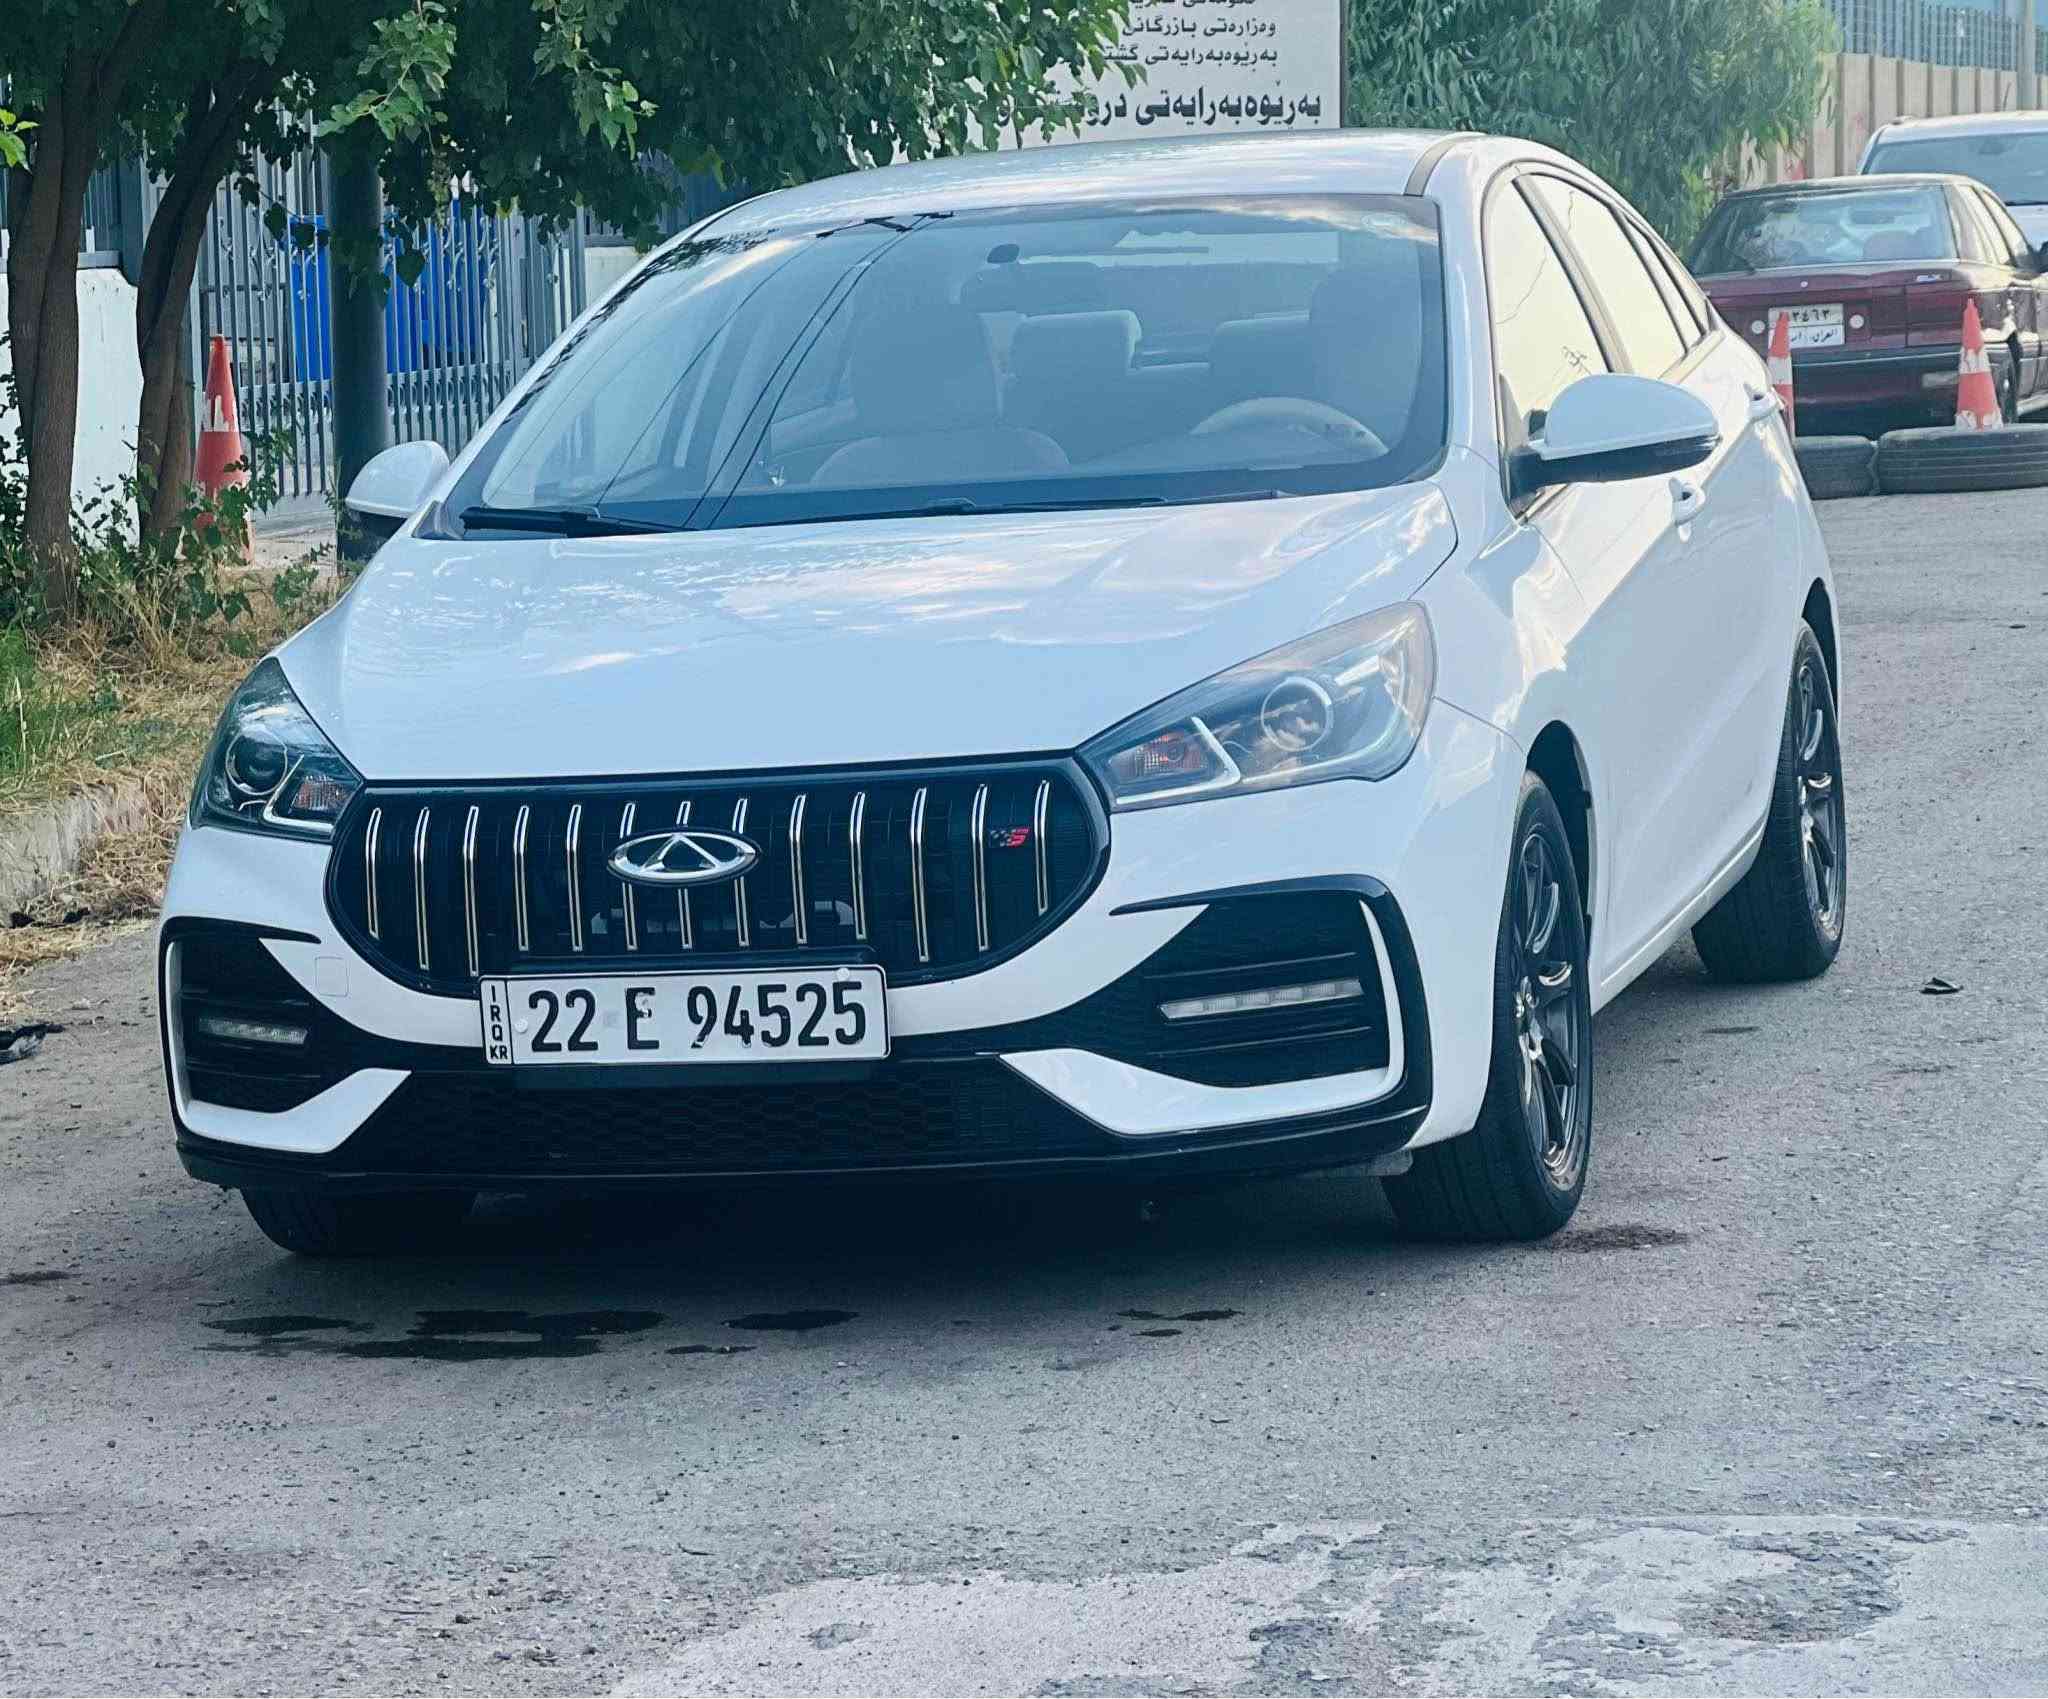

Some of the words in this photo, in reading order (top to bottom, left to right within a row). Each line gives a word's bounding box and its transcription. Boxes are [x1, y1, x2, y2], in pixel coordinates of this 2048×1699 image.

[1104, 44, 1139, 61] گشت
[489, 984, 503, 1042] IRQ
[528, 988, 599, 1052] 22
[625, 987, 660, 1050] E
[686, 981, 867, 1049] 94525
[489, 1044, 508, 1060] KR
